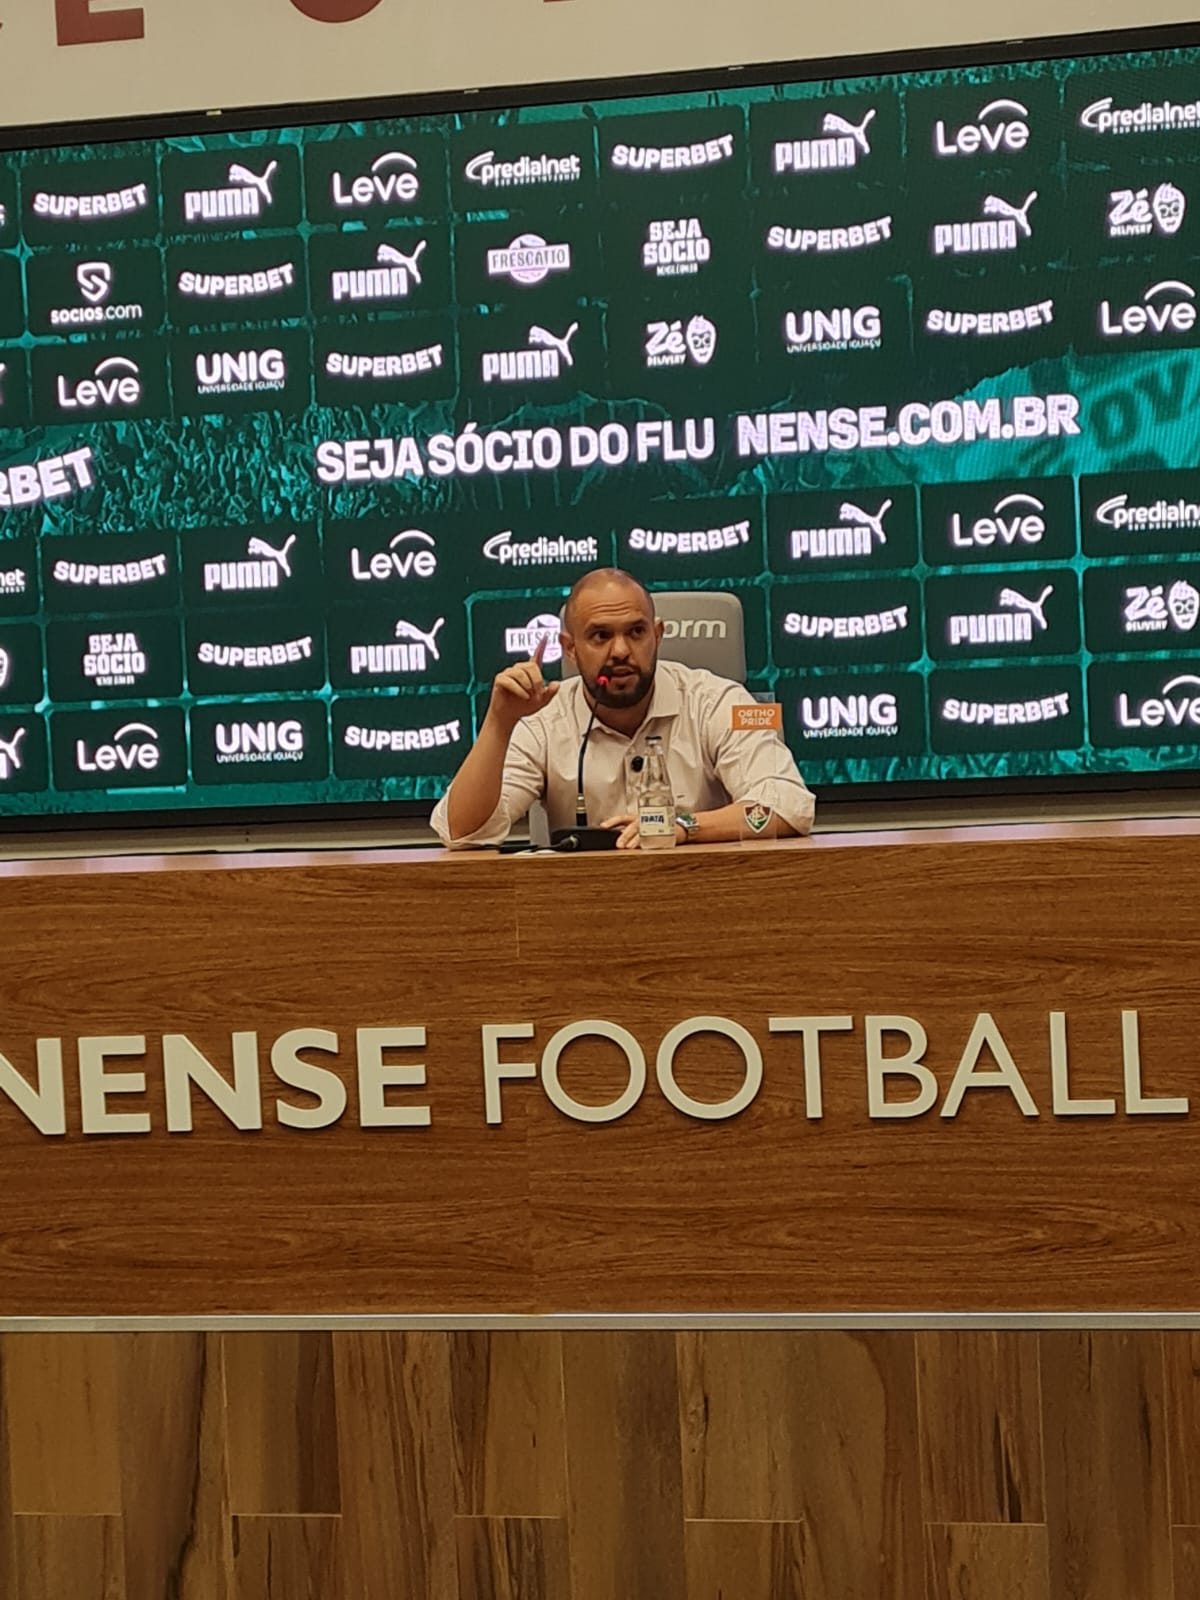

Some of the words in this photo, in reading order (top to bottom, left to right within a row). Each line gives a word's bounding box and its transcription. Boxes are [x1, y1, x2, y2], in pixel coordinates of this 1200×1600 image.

[612, 134, 733, 170] SUPERBET
[937, 117, 1030, 155] Leve
[478, 154, 580, 186] predialnet
[775, 138, 855, 172] PUMA
[33, 183, 146, 217] SUPERBET
[185, 187, 259, 220] PUMA
[333, 173, 418, 205] Leve
[1109, 187, 1153, 225] Zé
[649, 218, 702, 241] SEJA
[767, 216, 892, 251] SUPERBET
[935, 219, 1017, 254] PUMA
[179, 263, 293, 296] SUPERBET
[332, 266, 408, 300] PUMA
[50, 303, 142, 324] socios.com
[786, 306, 881, 342] UNIG
[926, 299, 1053, 335] SUPERBET
[1101, 301, 1197, 335] Leve
[645, 320, 687, 355] Zé
[196, 349, 285, 384] UNIG
[326, 344, 442, 377] SUPERBET
[482, 348, 560, 382] PUMA
[57, 374, 140, 407] Leve
[316, 437, 424, 482] SEJA
[428, 422, 562, 476] SÓCIO
[569, 423, 629, 467] DO
[636, 417, 715, 463] FLU
[737, 394, 1081, 456] NENSE.COM.BR
[953, 511, 1045, 547] Leve
[1111, 499, 1200, 529] predialn
[496, 535, 598, 565] predialnet
[628, 520, 750, 553] SUPERBET
[791, 527, 871, 559] PUMA
[53, 554, 166, 585] SUPERBET
[205, 560, 279, 591] PUMA
[351, 547, 437, 580] Leve
[1124, 585, 1168, 621] Zé
[784, 605, 908, 638] SUPERBET
[950, 612, 1032, 645] PUMA
[88, 633, 138, 654] SEJA
[197, 636, 312, 667] SUPERBET
[351, 642, 426, 674] PUMA
[738, 708, 775, 719] ORTHO
[741, 717, 772, 726] PRIDE
[802, 693, 897, 729] UNIG
[942, 692, 1069, 725] SUPERBET
[215, 720, 303, 754] UNIG
[344, 719, 460, 751] SUPERBET
[77, 740, 159, 771] Leve
[0, 1027, 432, 1135] NENSE
[481, 1010, 1189, 1126] FOOTBALL
